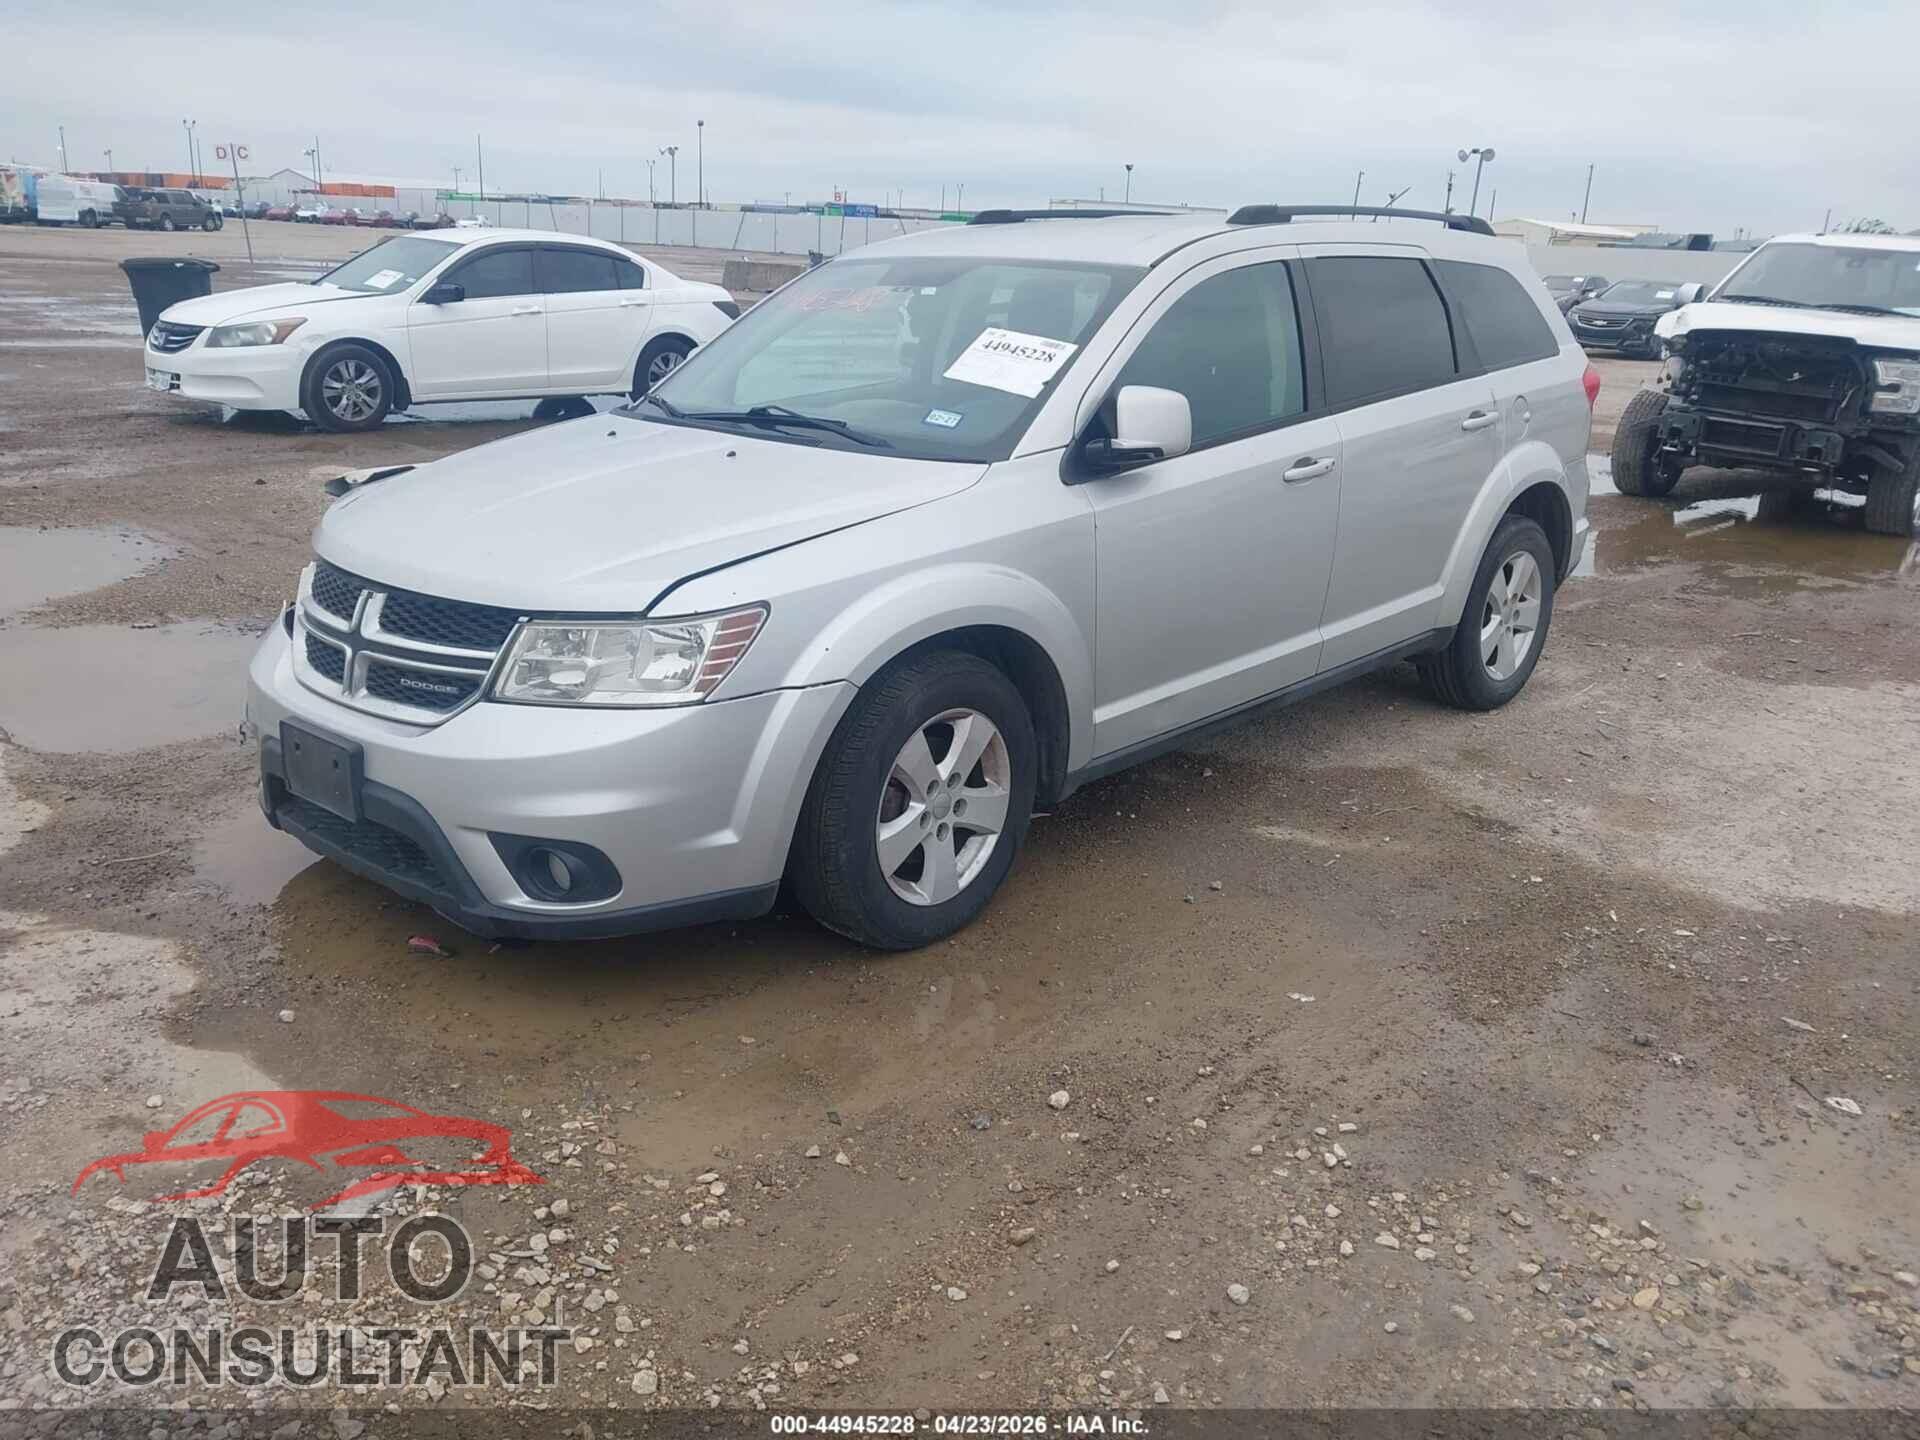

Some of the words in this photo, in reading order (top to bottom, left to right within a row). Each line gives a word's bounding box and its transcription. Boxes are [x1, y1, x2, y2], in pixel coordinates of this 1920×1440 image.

[216, 146, 227, 160] D
[237, 146, 249, 160] C
[981, 339, 1057, 363] 44945228
[400, 677, 460, 695] DODGE
